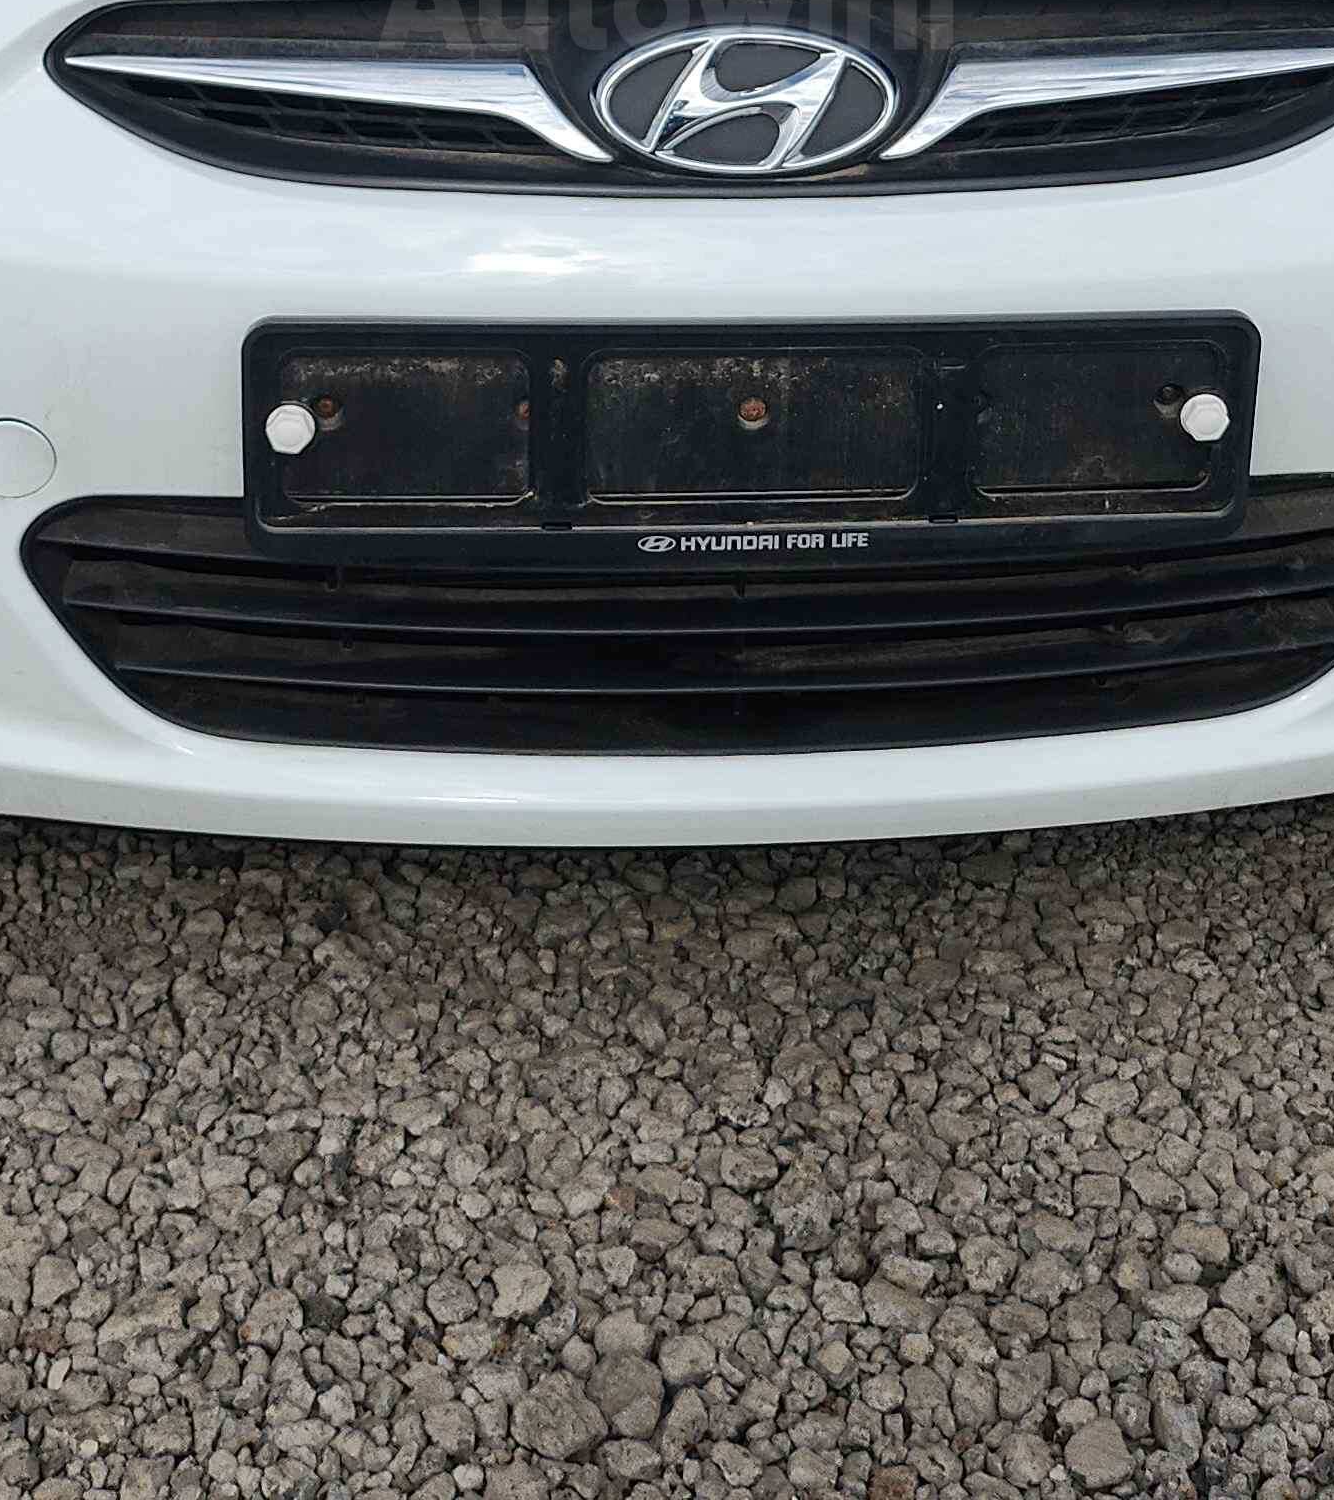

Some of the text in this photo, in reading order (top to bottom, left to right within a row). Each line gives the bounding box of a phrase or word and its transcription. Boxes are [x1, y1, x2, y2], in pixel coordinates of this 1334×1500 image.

[679, 532, 870, 552] HYUNDAI FOR LIFE
